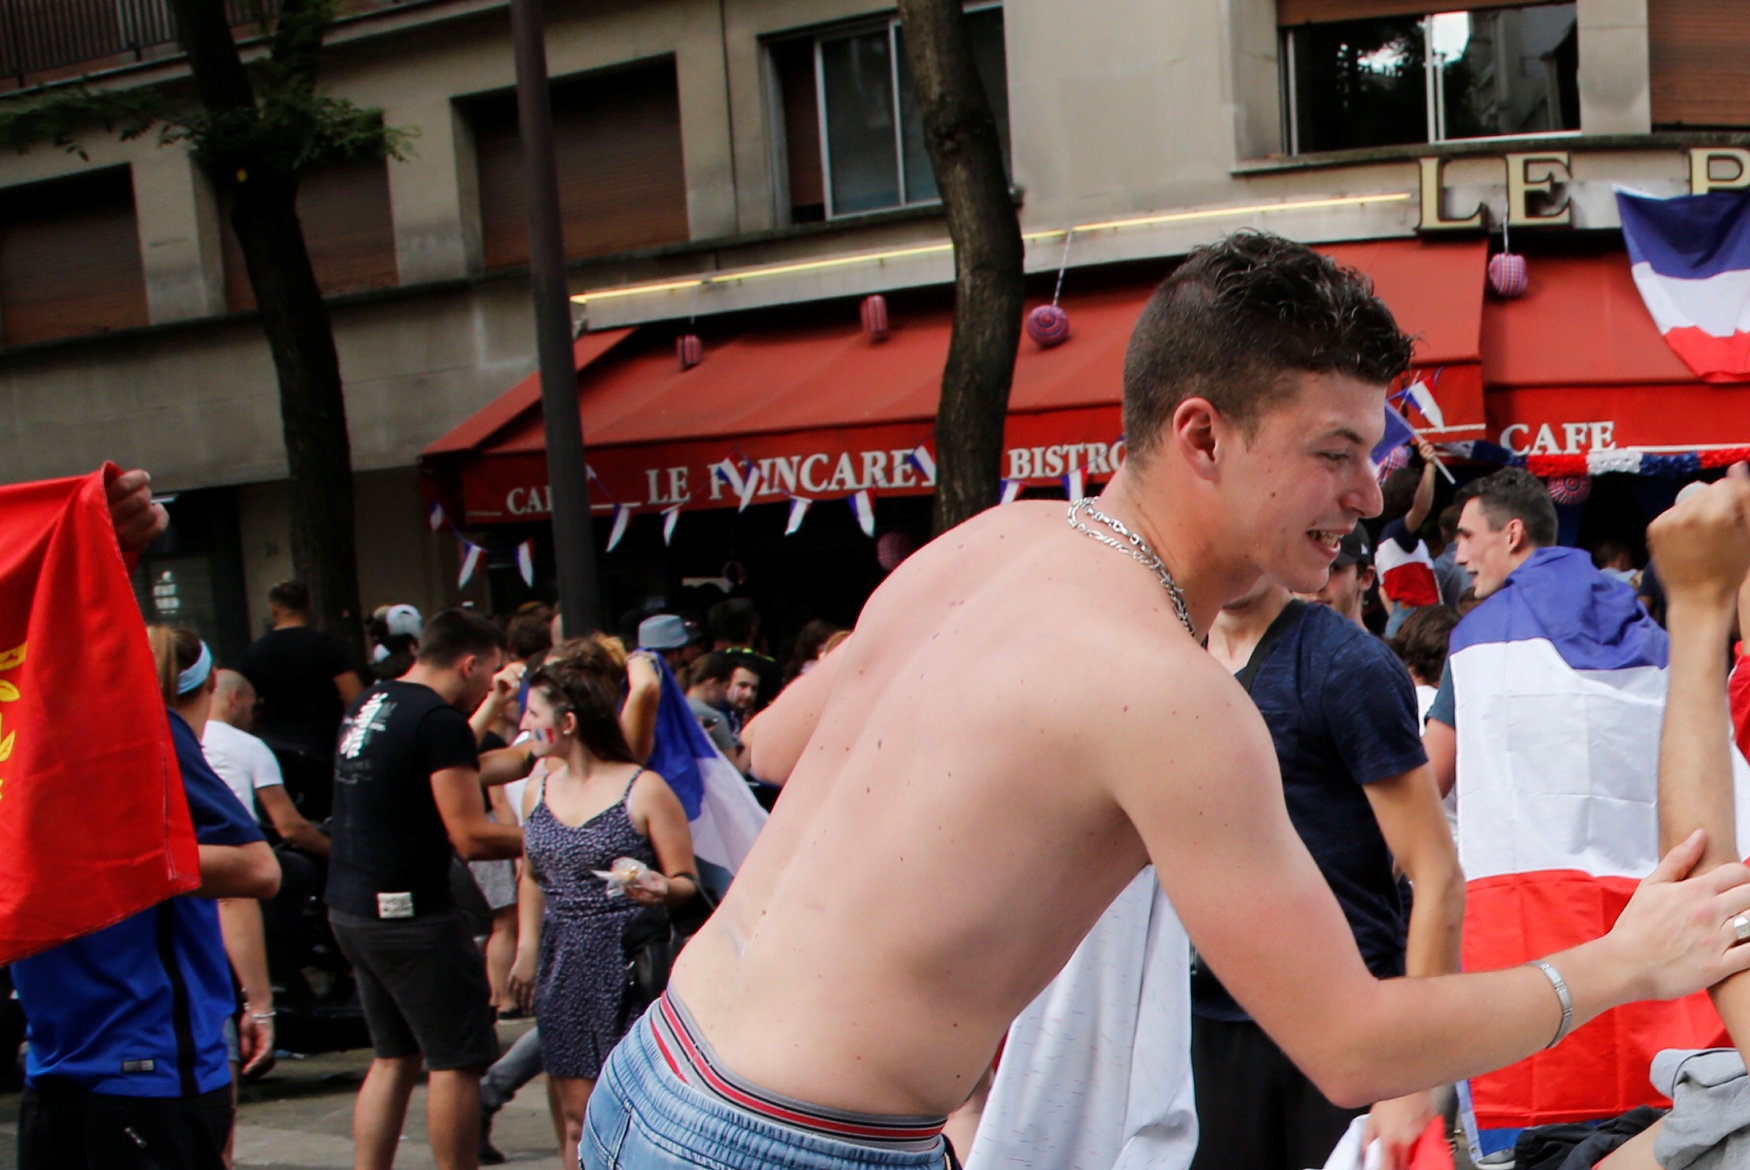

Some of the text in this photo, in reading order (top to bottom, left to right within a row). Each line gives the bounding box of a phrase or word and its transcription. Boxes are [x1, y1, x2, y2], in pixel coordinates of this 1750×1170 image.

[1417, 148, 1574, 233] LE
[1500, 420, 1617, 456] CAFE
[645, 466, 692, 505] LE
